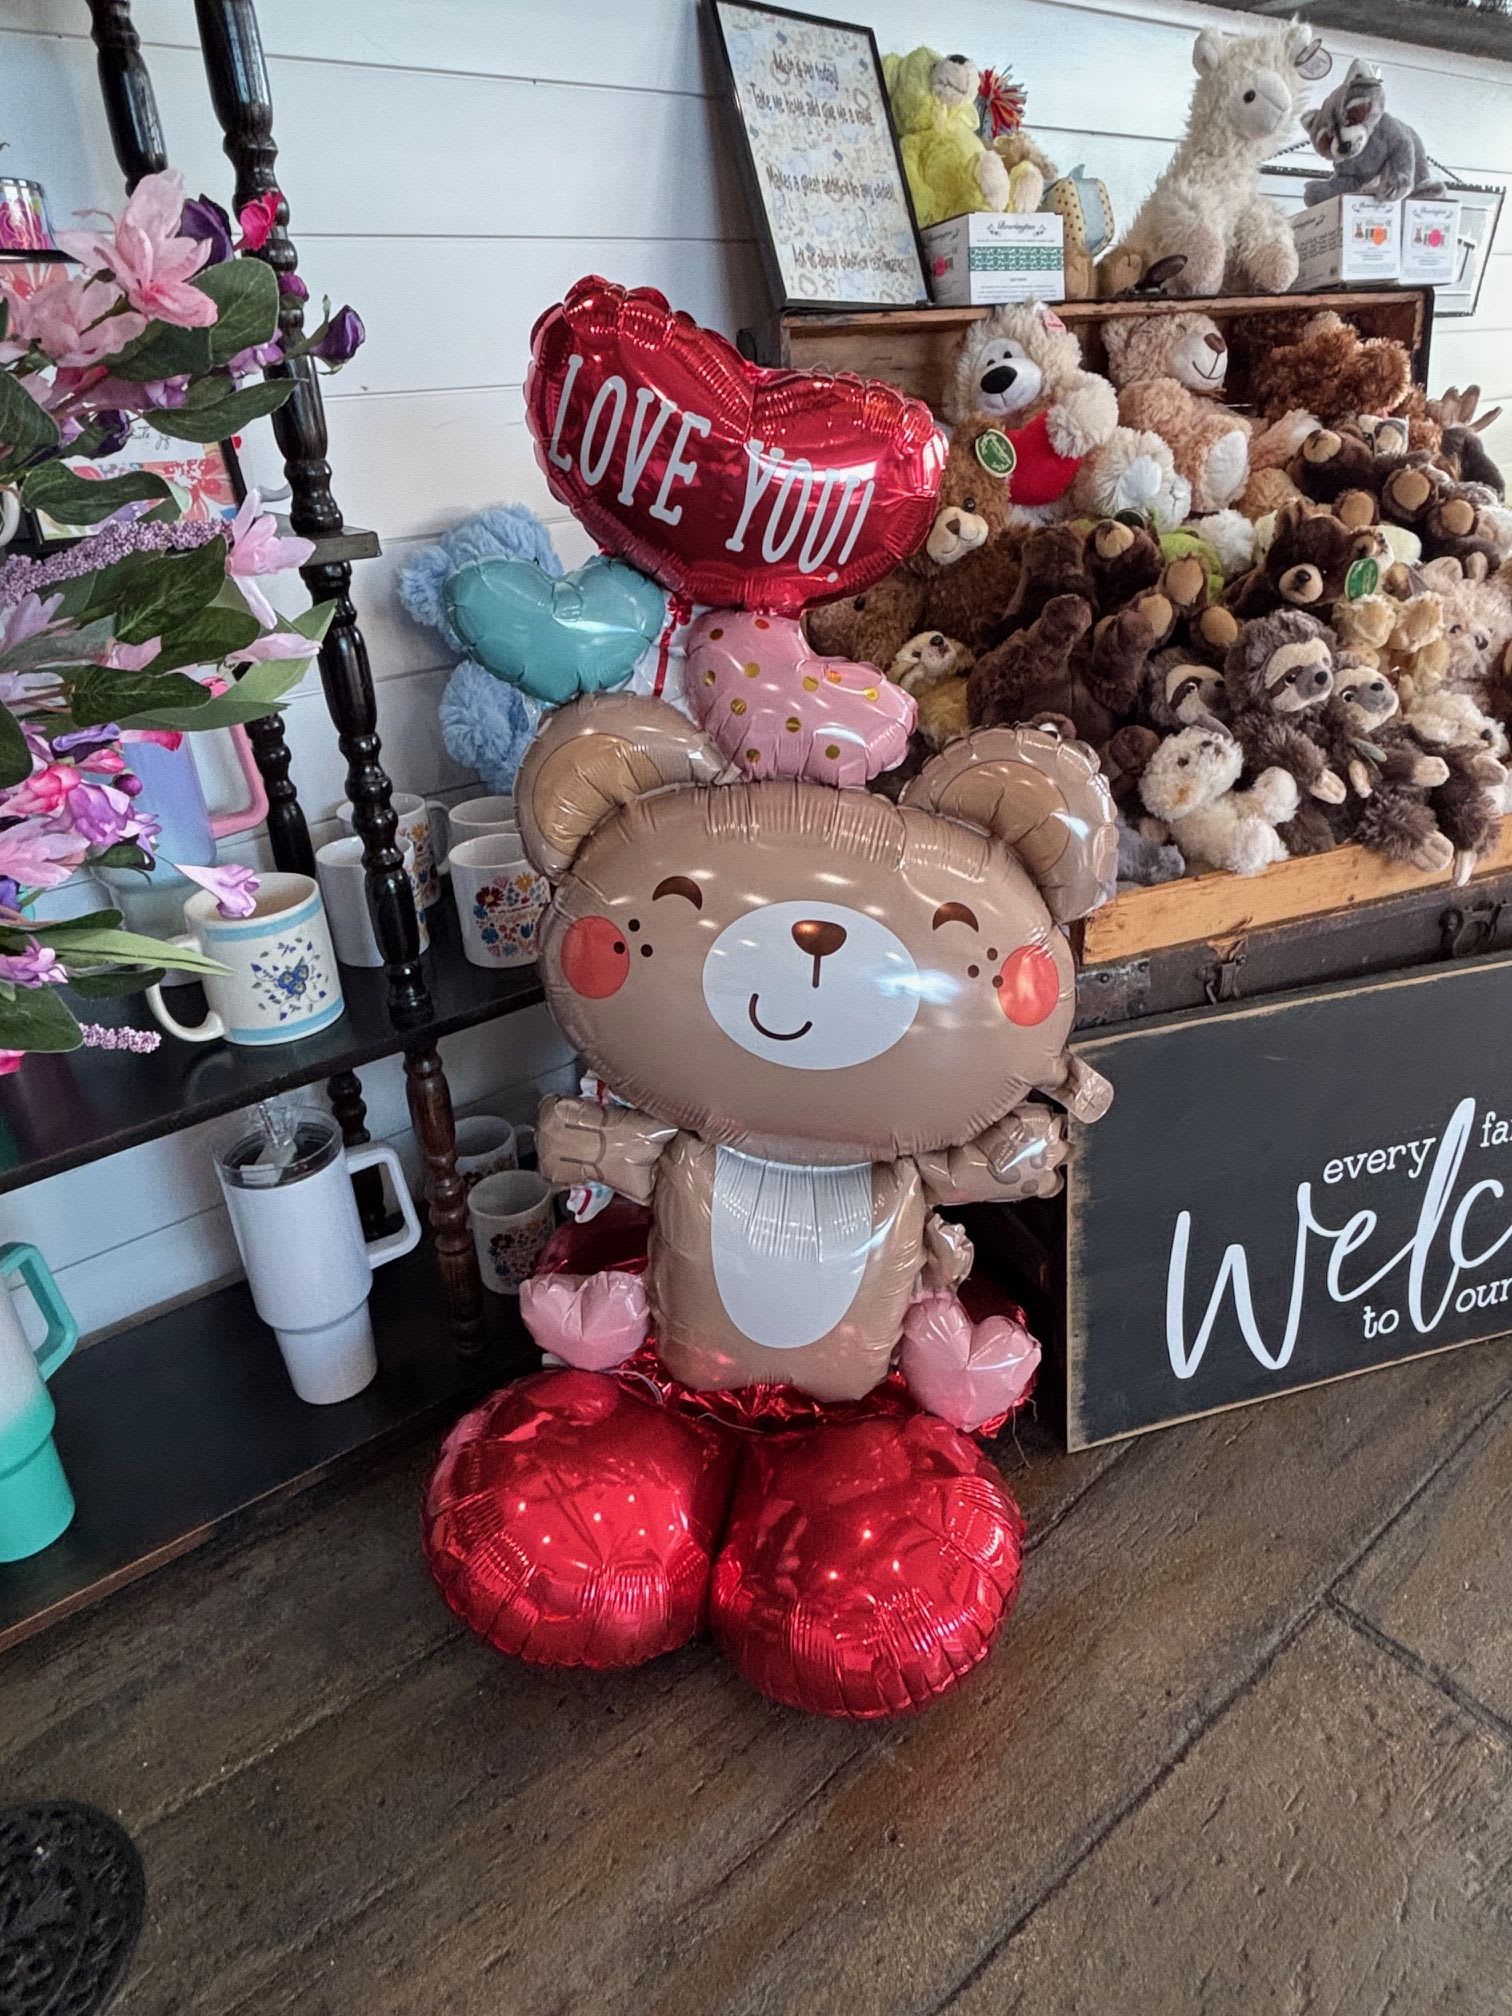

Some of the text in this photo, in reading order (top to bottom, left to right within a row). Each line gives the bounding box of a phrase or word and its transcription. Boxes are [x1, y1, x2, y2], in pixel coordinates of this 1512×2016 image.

[750, 82, 772, 111] Take
[772, 93, 784, 113] me
[783, 92, 806, 117] home
[806, 97, 821, 118] and
[836, 105, 848, 123] me
[766, 164, 793, 192] Makes
[800, 174, 819, 198] great
[817, 248, 837, 269] about
[548, 354, 875, 583] LOVE YOU!
[1323, 1111, 1512, 1184] every fa
[1363, 1305, 1399, 1339] to
